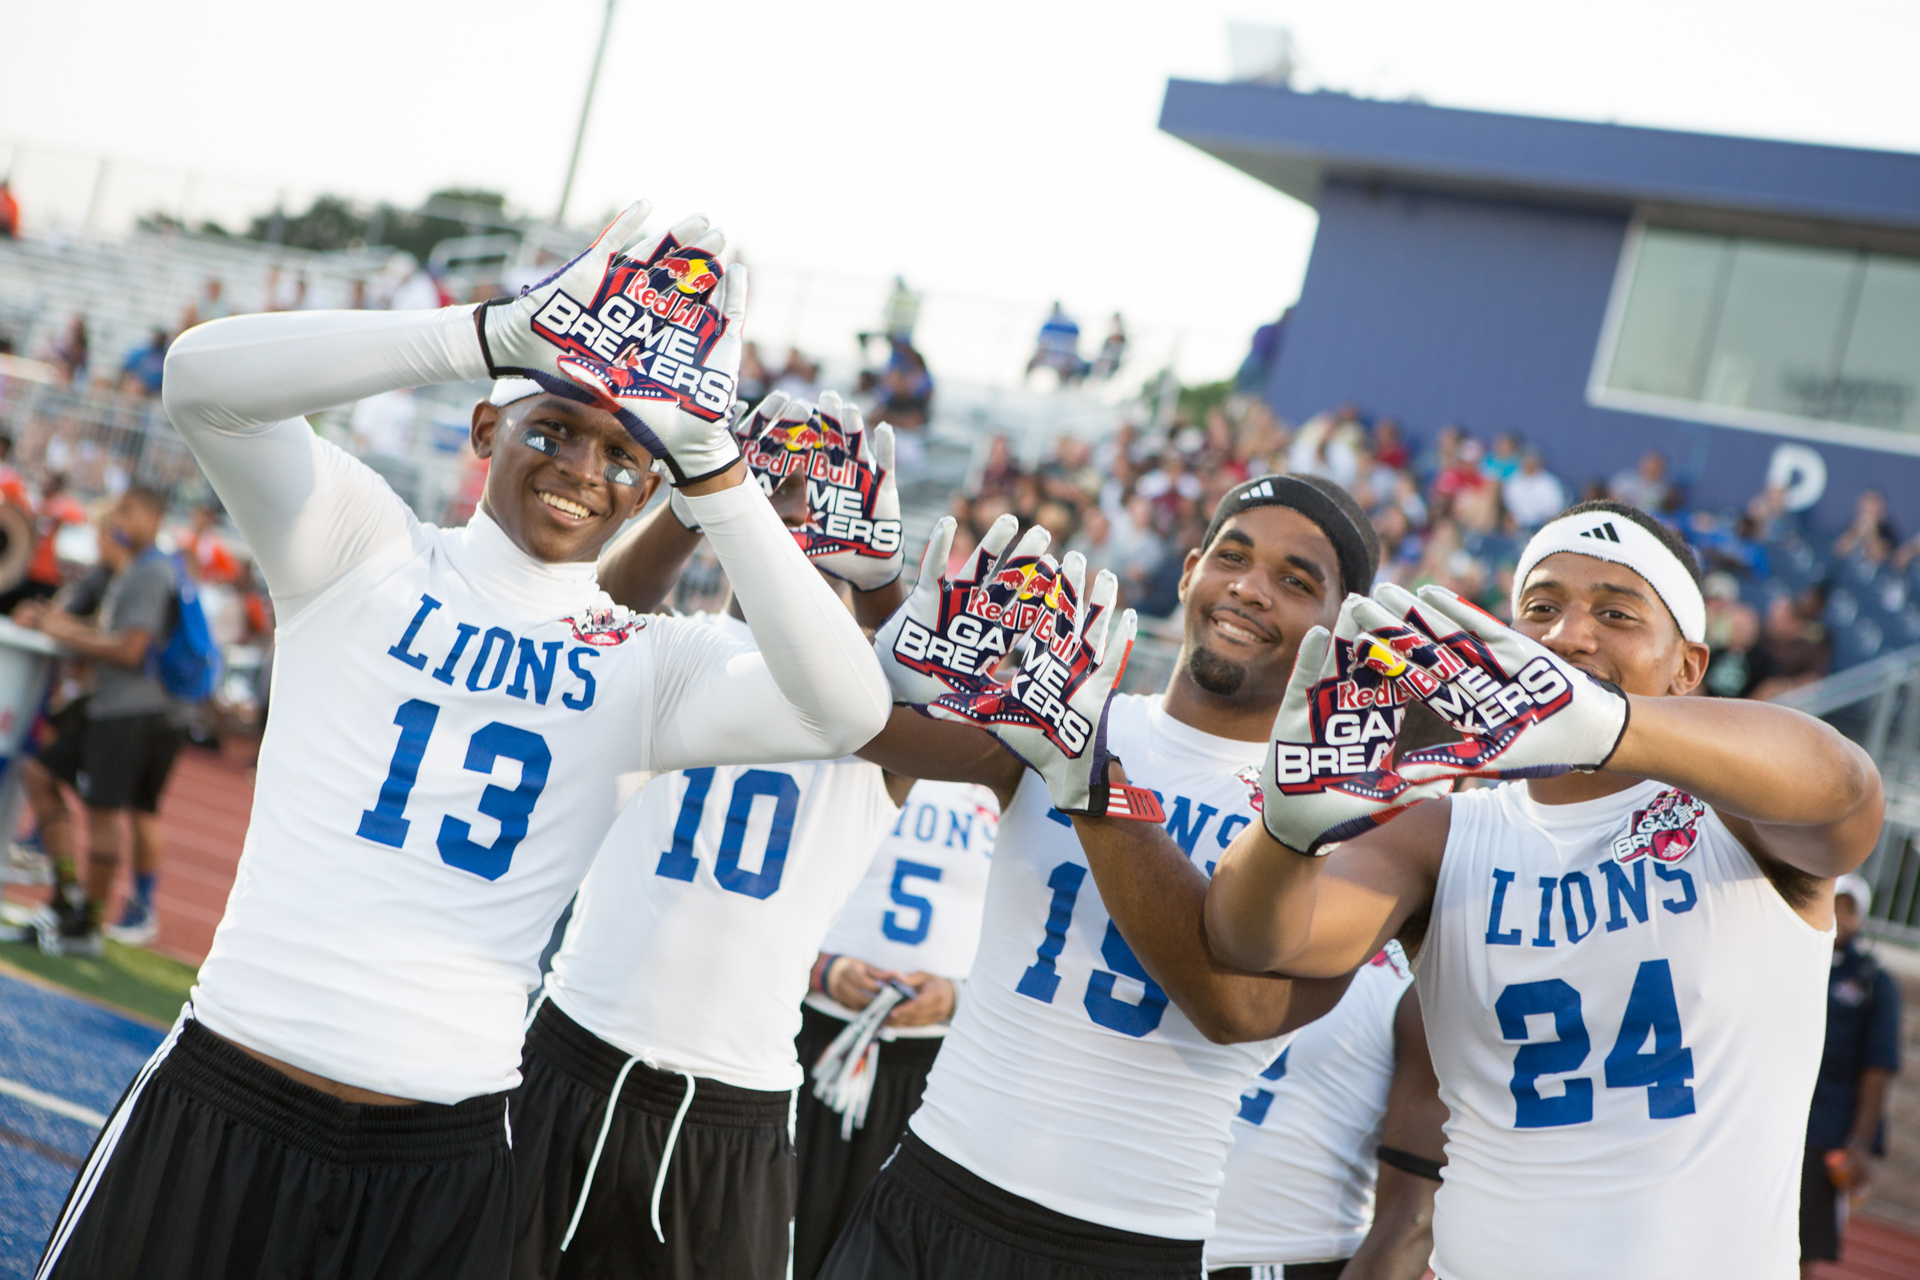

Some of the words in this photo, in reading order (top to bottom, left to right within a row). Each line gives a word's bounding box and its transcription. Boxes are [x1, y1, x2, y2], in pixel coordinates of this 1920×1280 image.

[623, 269, 680, 319] Red
[534, 292, 734, 413] BREKERS
[743, 440, 789, 476] Red
[810, 451, 858, 489] Bull
[387, 593, 600, 711] LIONS
[966, 586, 1020, 630] Red
[1337, 678, 1392, 710] Red
[355, 698, 552, 881] 13
[655, 766, 800, 900] 10
[892, 801, 994, 859] ION
[882, 858, 942, 945] 5
[1485, 857, 1698, 947] LIONS
[1495, 958, 1696, 1129] 24
